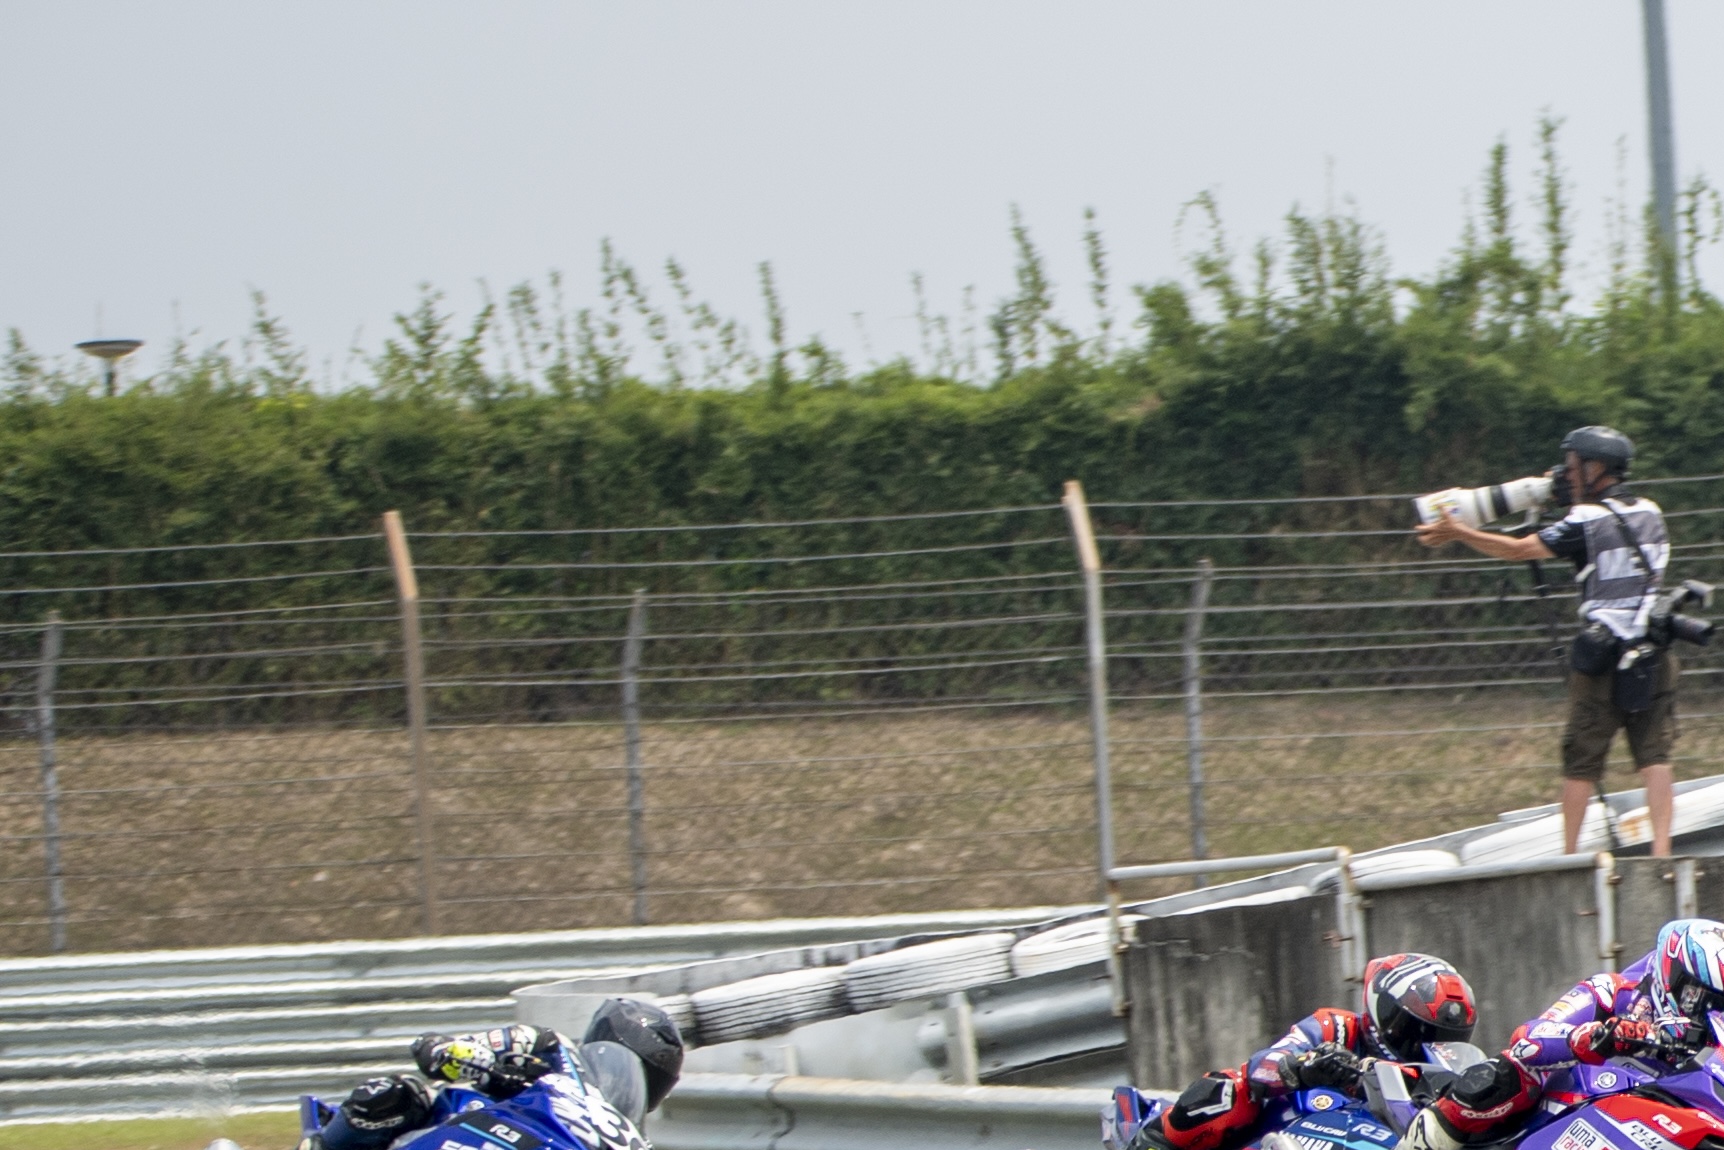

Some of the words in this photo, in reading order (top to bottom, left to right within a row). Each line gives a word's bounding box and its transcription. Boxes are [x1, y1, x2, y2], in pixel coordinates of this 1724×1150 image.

[1352, 1122, 1394, 1142] R3
[1568, 1121, 1597, 1148] uma
[1652, 1113, 1683, 1135] R3
